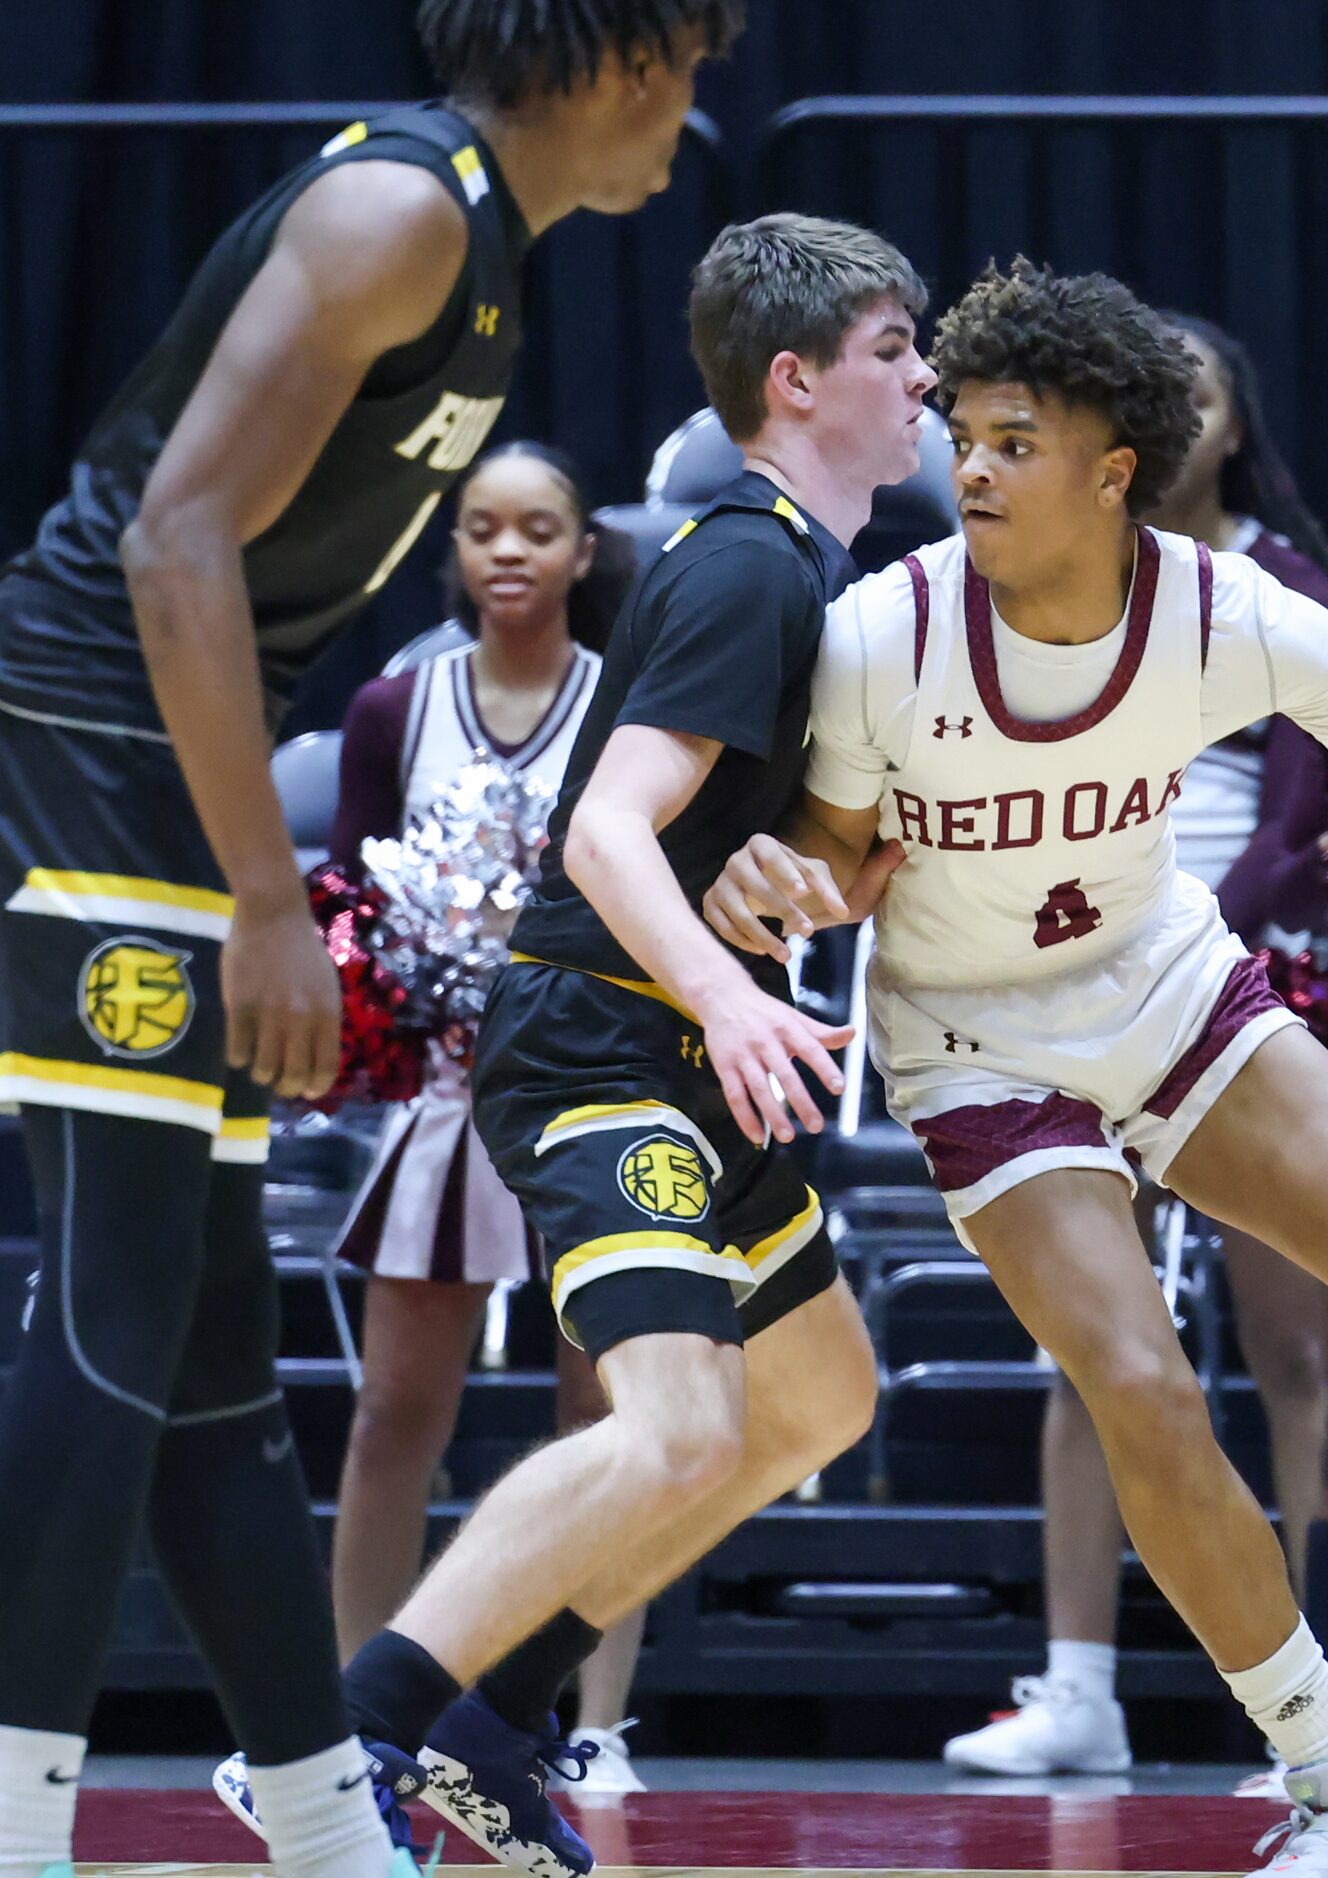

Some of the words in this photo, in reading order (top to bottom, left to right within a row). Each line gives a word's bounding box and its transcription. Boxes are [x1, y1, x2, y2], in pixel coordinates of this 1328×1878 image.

[893, 787, 1044, 851] RED
[1062, 768, 1182, 841] OAK
[1032, 878, 1102, 949] 4
